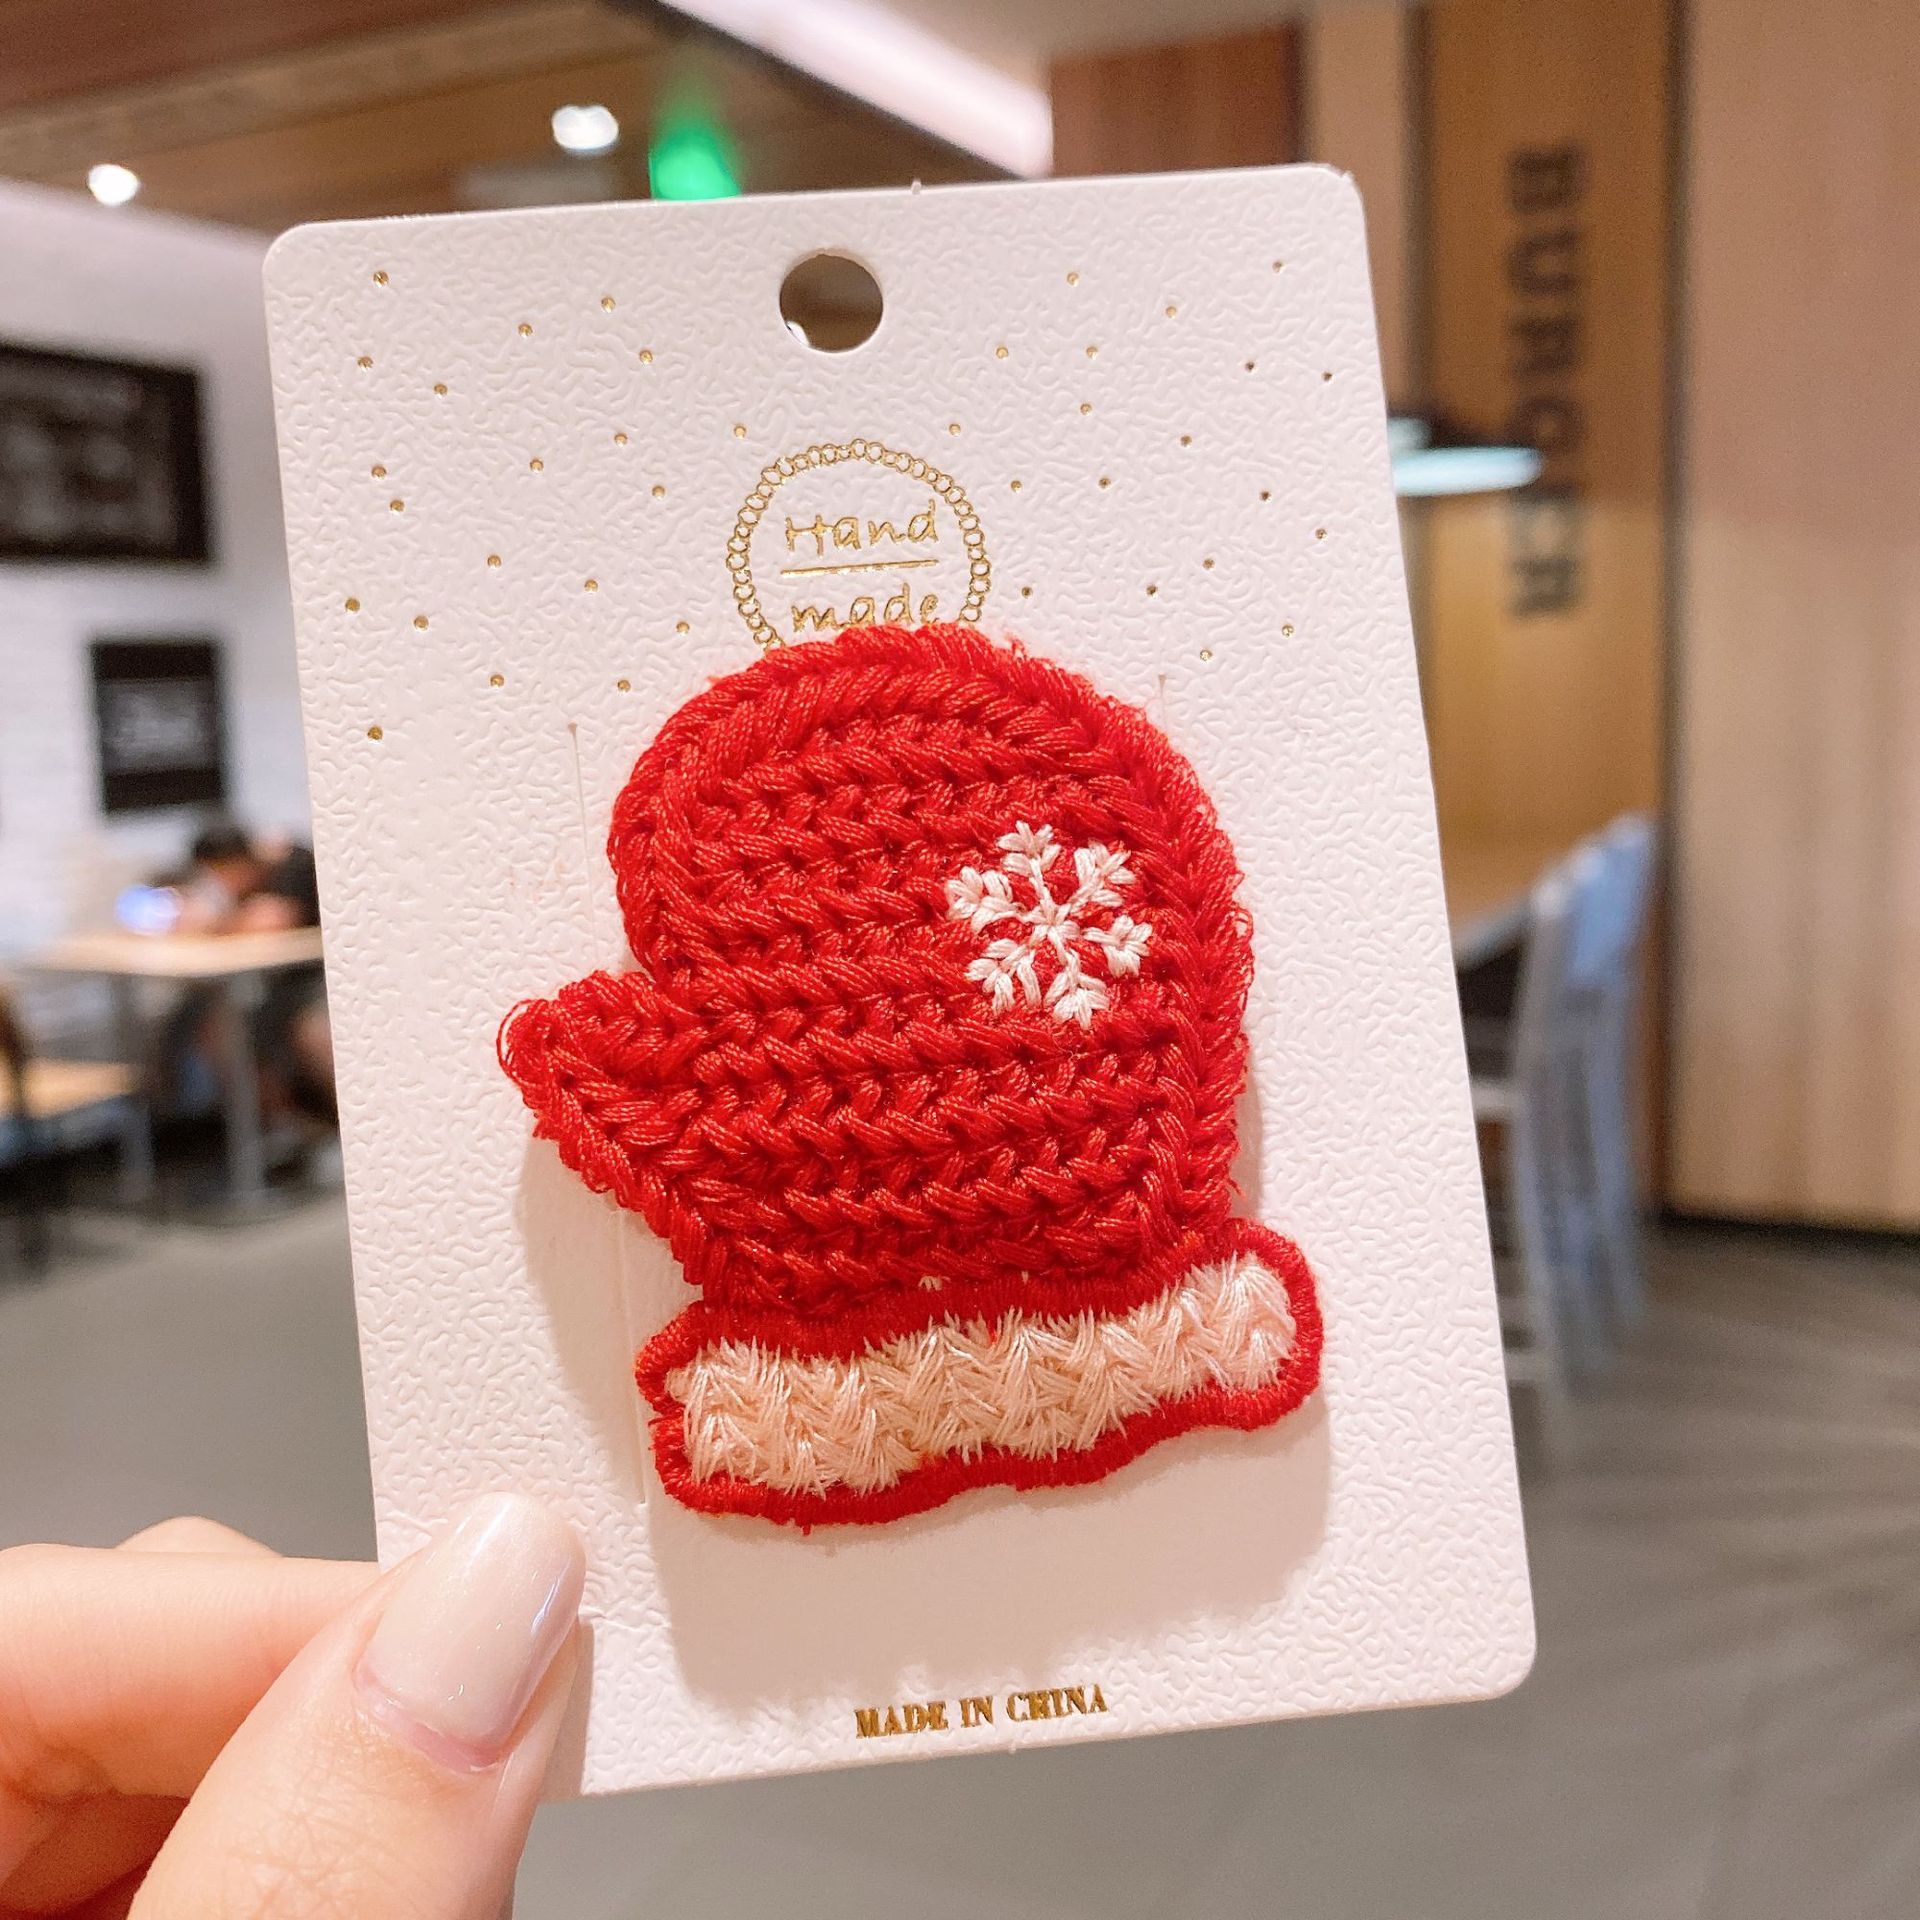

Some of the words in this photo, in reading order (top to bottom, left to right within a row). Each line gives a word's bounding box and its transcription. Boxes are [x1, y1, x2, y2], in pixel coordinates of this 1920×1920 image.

[785, 499, 939, 556] Hand
[791, 582, 939, 632] made
[854, 1700, 949, 1739] MADE
[959, 1695, 994, 1728] IN
[1006, 1683, 1109, 1722] CHINA
